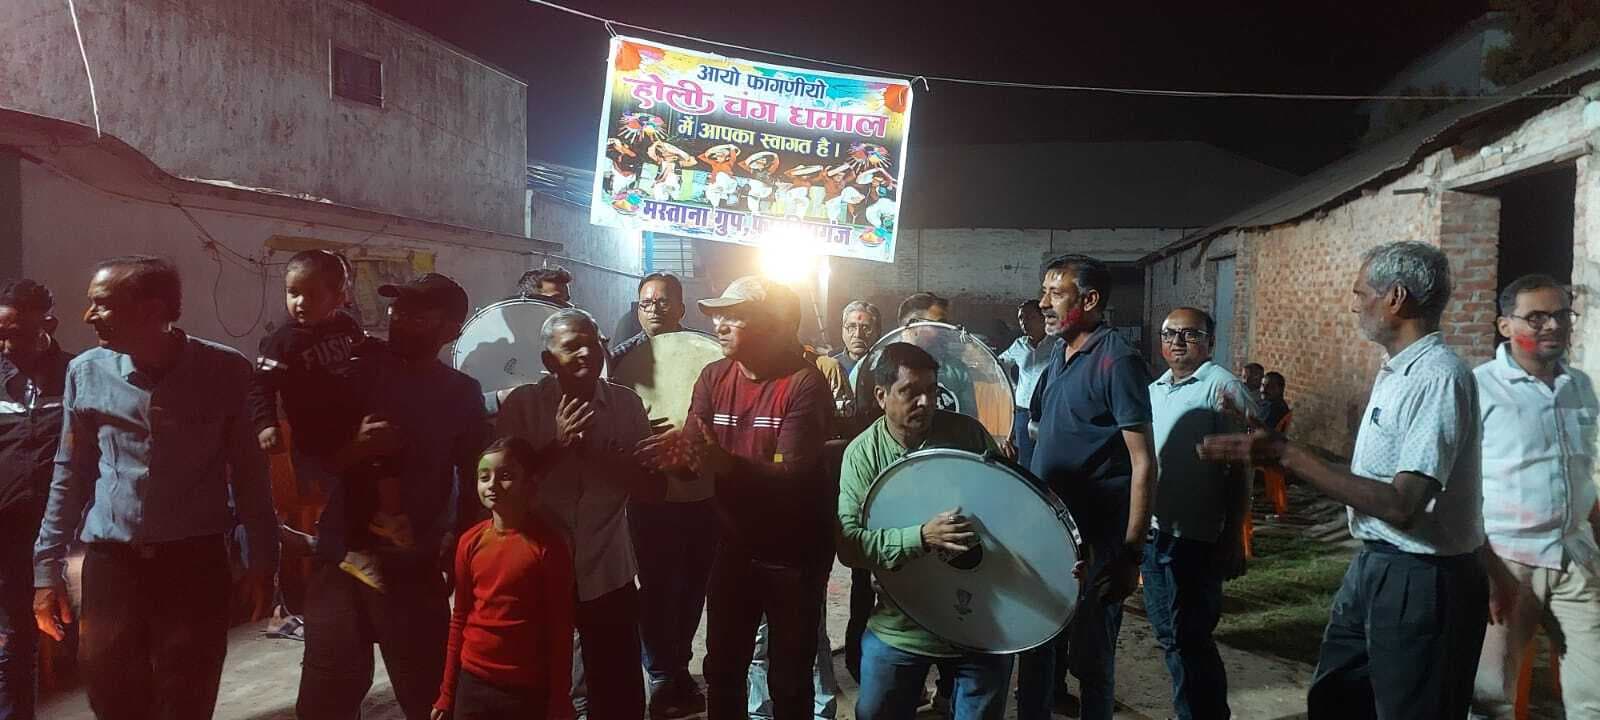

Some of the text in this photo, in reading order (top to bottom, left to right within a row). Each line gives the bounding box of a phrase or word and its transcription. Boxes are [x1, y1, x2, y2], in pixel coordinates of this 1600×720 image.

[697, 64, 828, 99] आयो फागणीयो
[624, 73, 889, 138] होली चंग धमाल
[678, 115, 695, 136] में
[698, 123, 756, 145] आपका
[760, 133, 813, 154] स्वागत
[643, 199, 711, 227] मस्ताना
